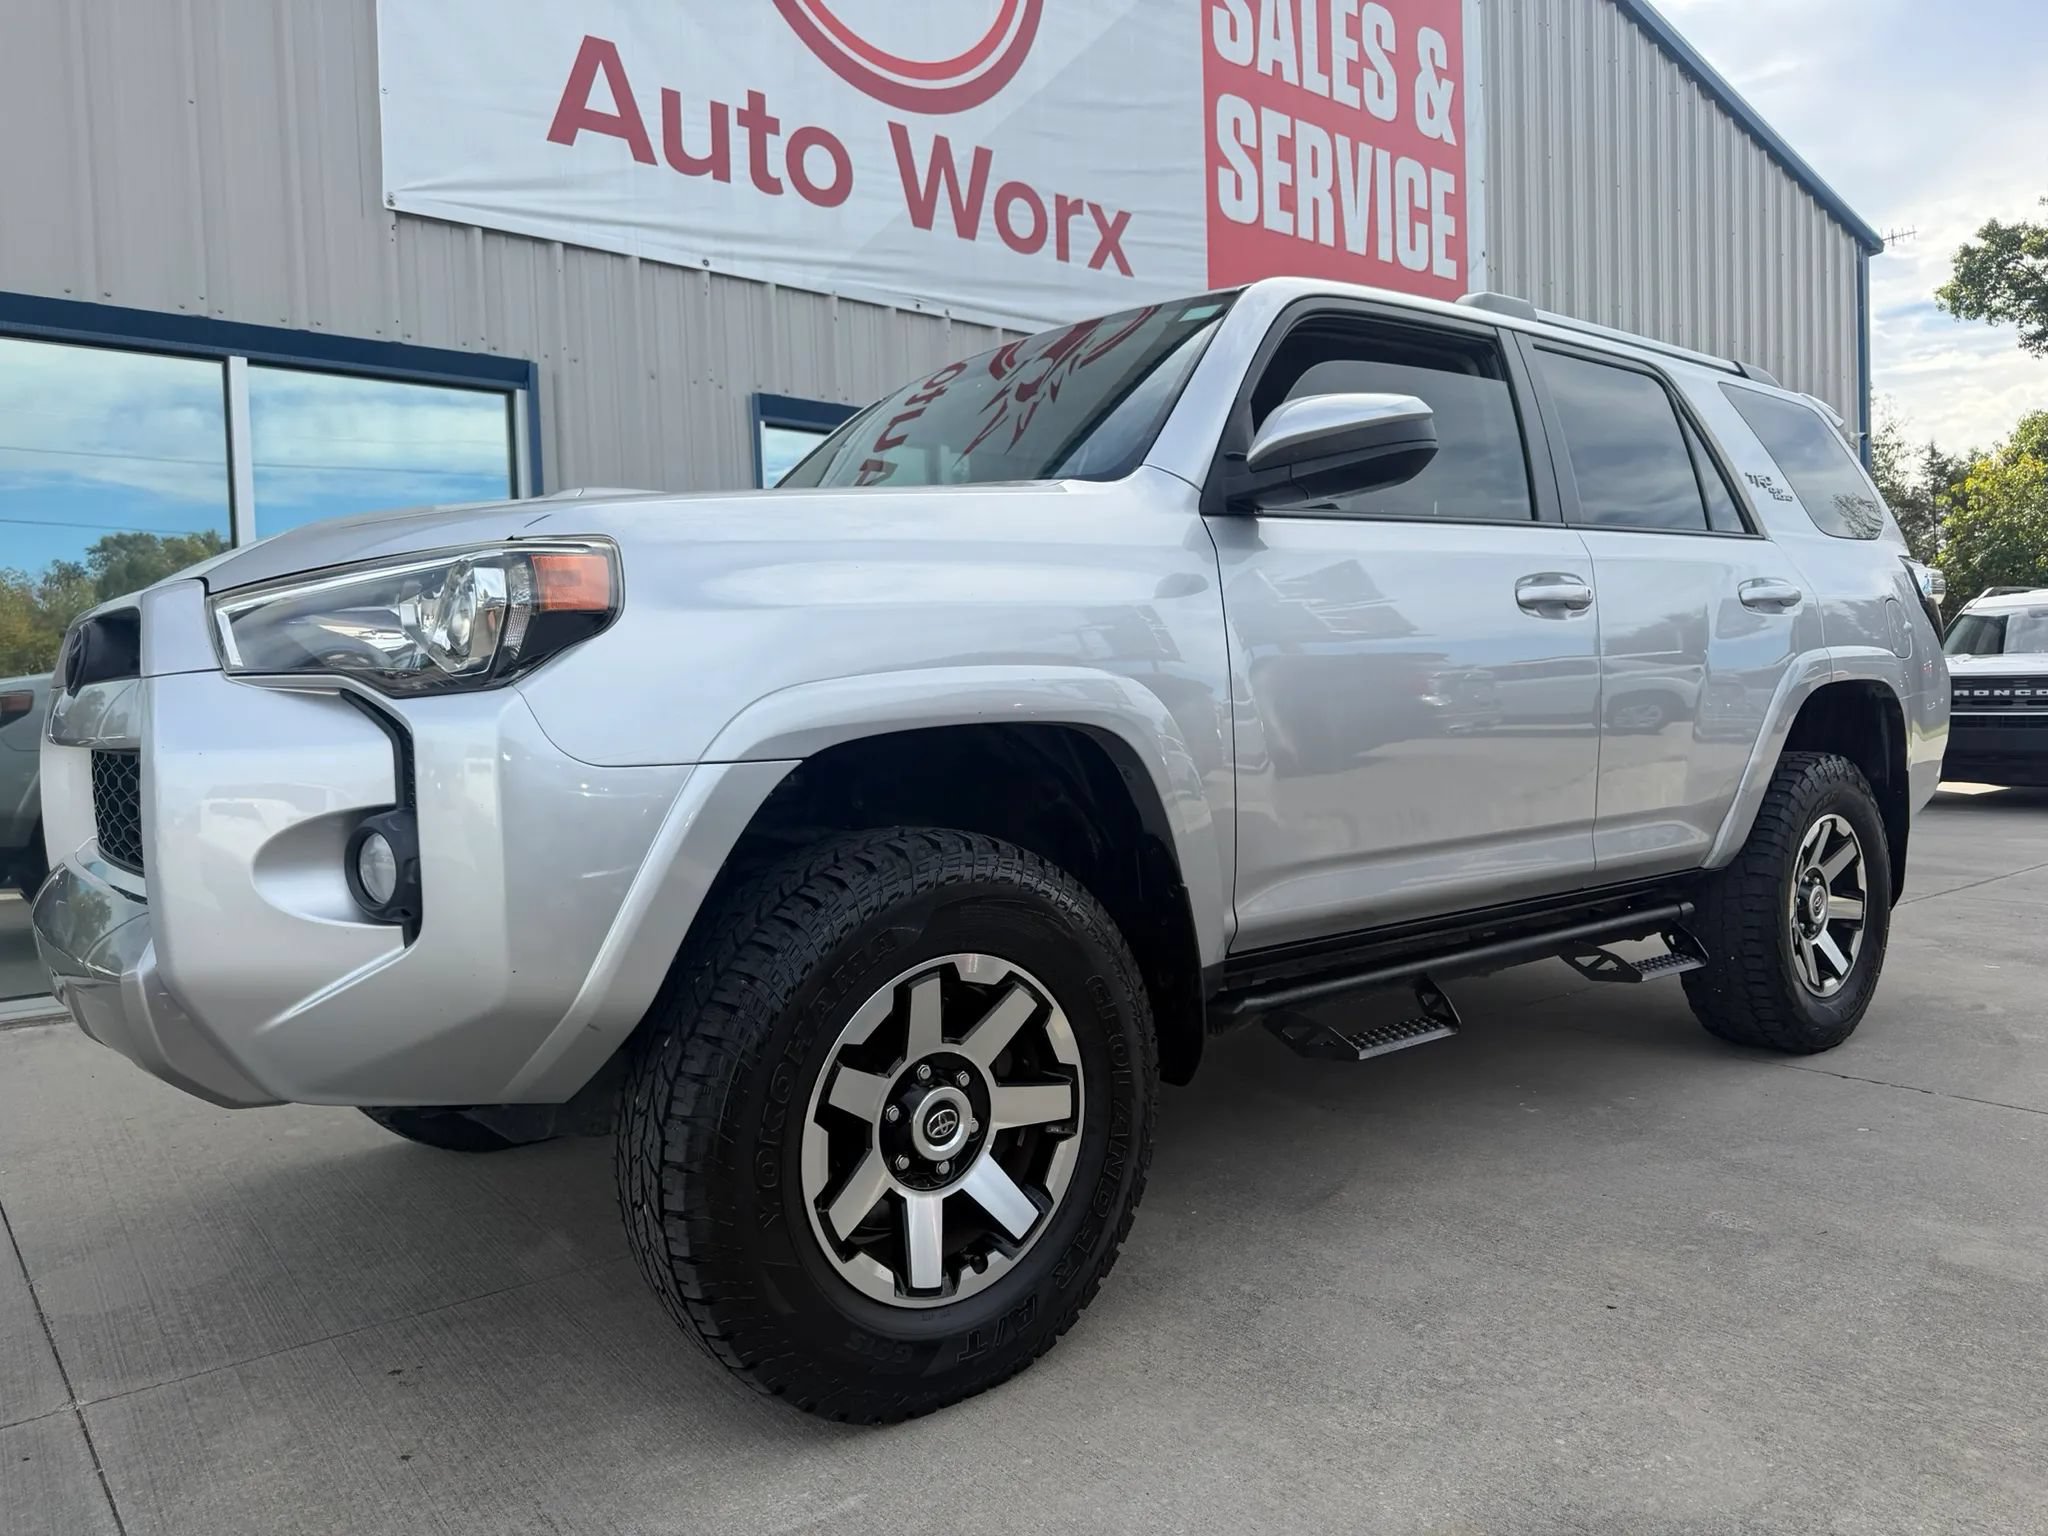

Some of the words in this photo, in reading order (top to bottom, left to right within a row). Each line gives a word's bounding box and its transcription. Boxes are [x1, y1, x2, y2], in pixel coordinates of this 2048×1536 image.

[546, 34, 854, 208] Auto
[887, 120, 1135, 278] Worx
[1212, 0, 1398, 122] SALES
[1414, 26, 1457, 146] &
[1216, 93, 1458, 280] SERVICE
[1953, 689, 2048, 697] RONCO
